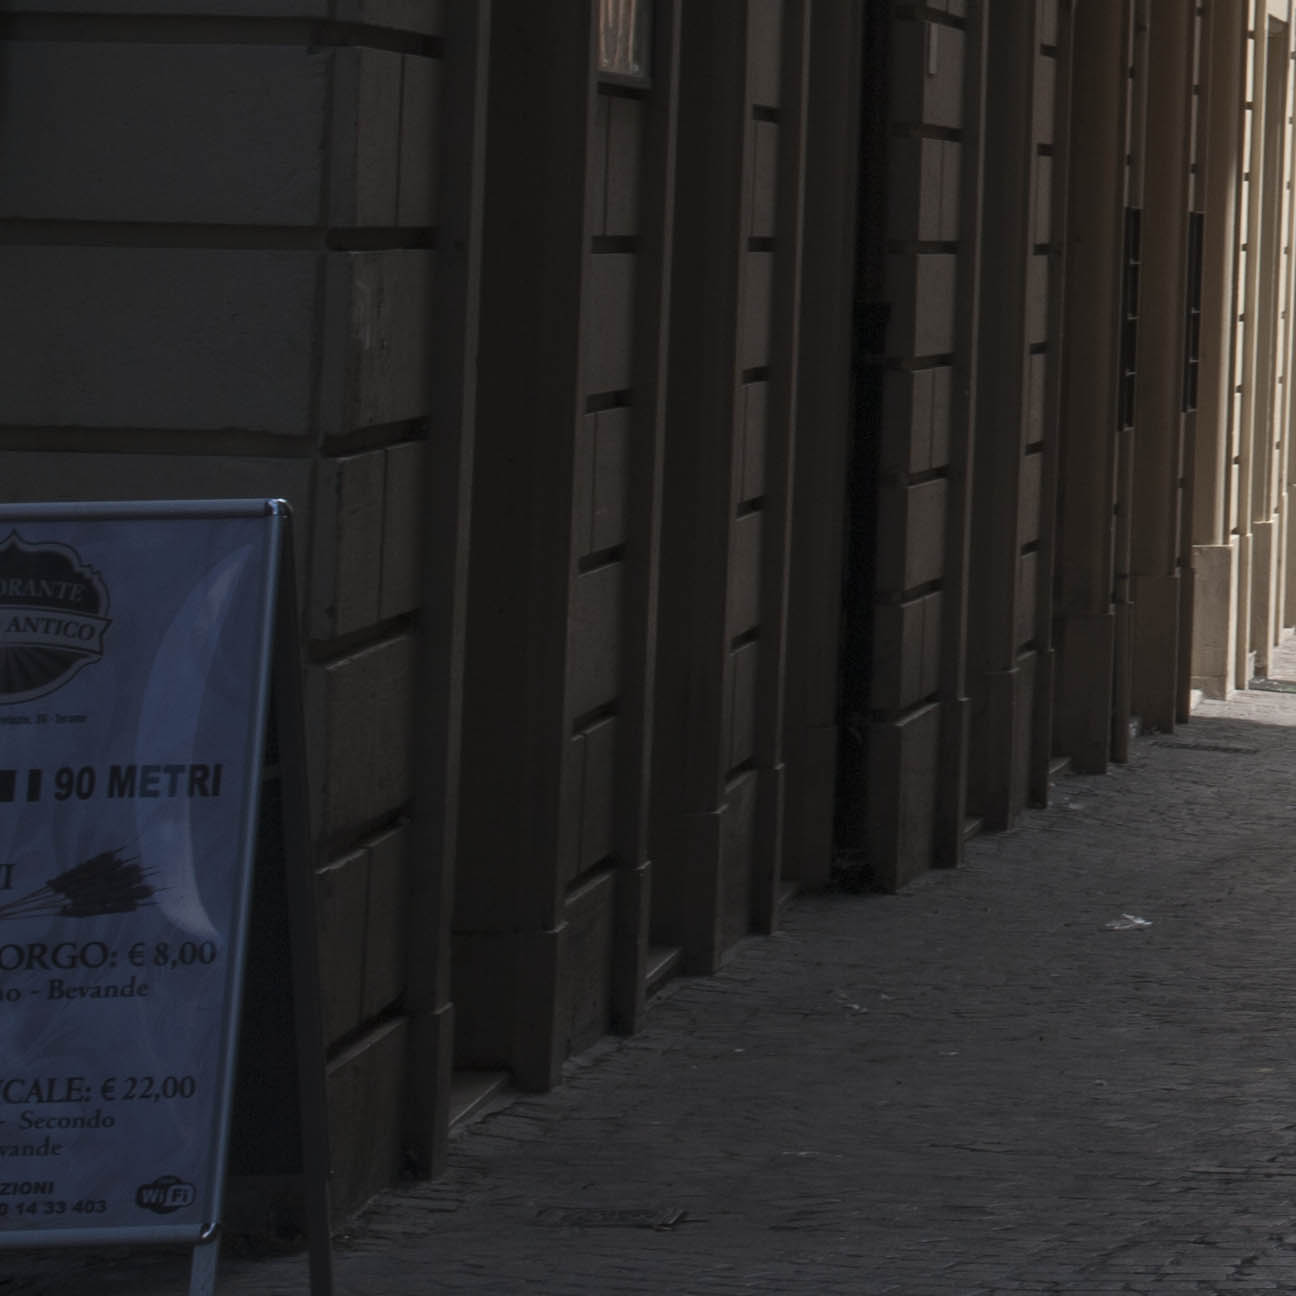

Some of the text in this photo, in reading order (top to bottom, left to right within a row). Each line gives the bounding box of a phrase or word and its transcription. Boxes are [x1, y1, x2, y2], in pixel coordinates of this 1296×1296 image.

[5, 615, 96, 641] ANTICO
[54, 764, 223, 801] 90 METRI
[0, 941, 217, 970] ORGO: € 8,00
[48, 976, 150, 1001] Bevande
[0, 1075, 196, 1104] CALE: € 22,00
[18, 1110, 116, 1131] Secondo
